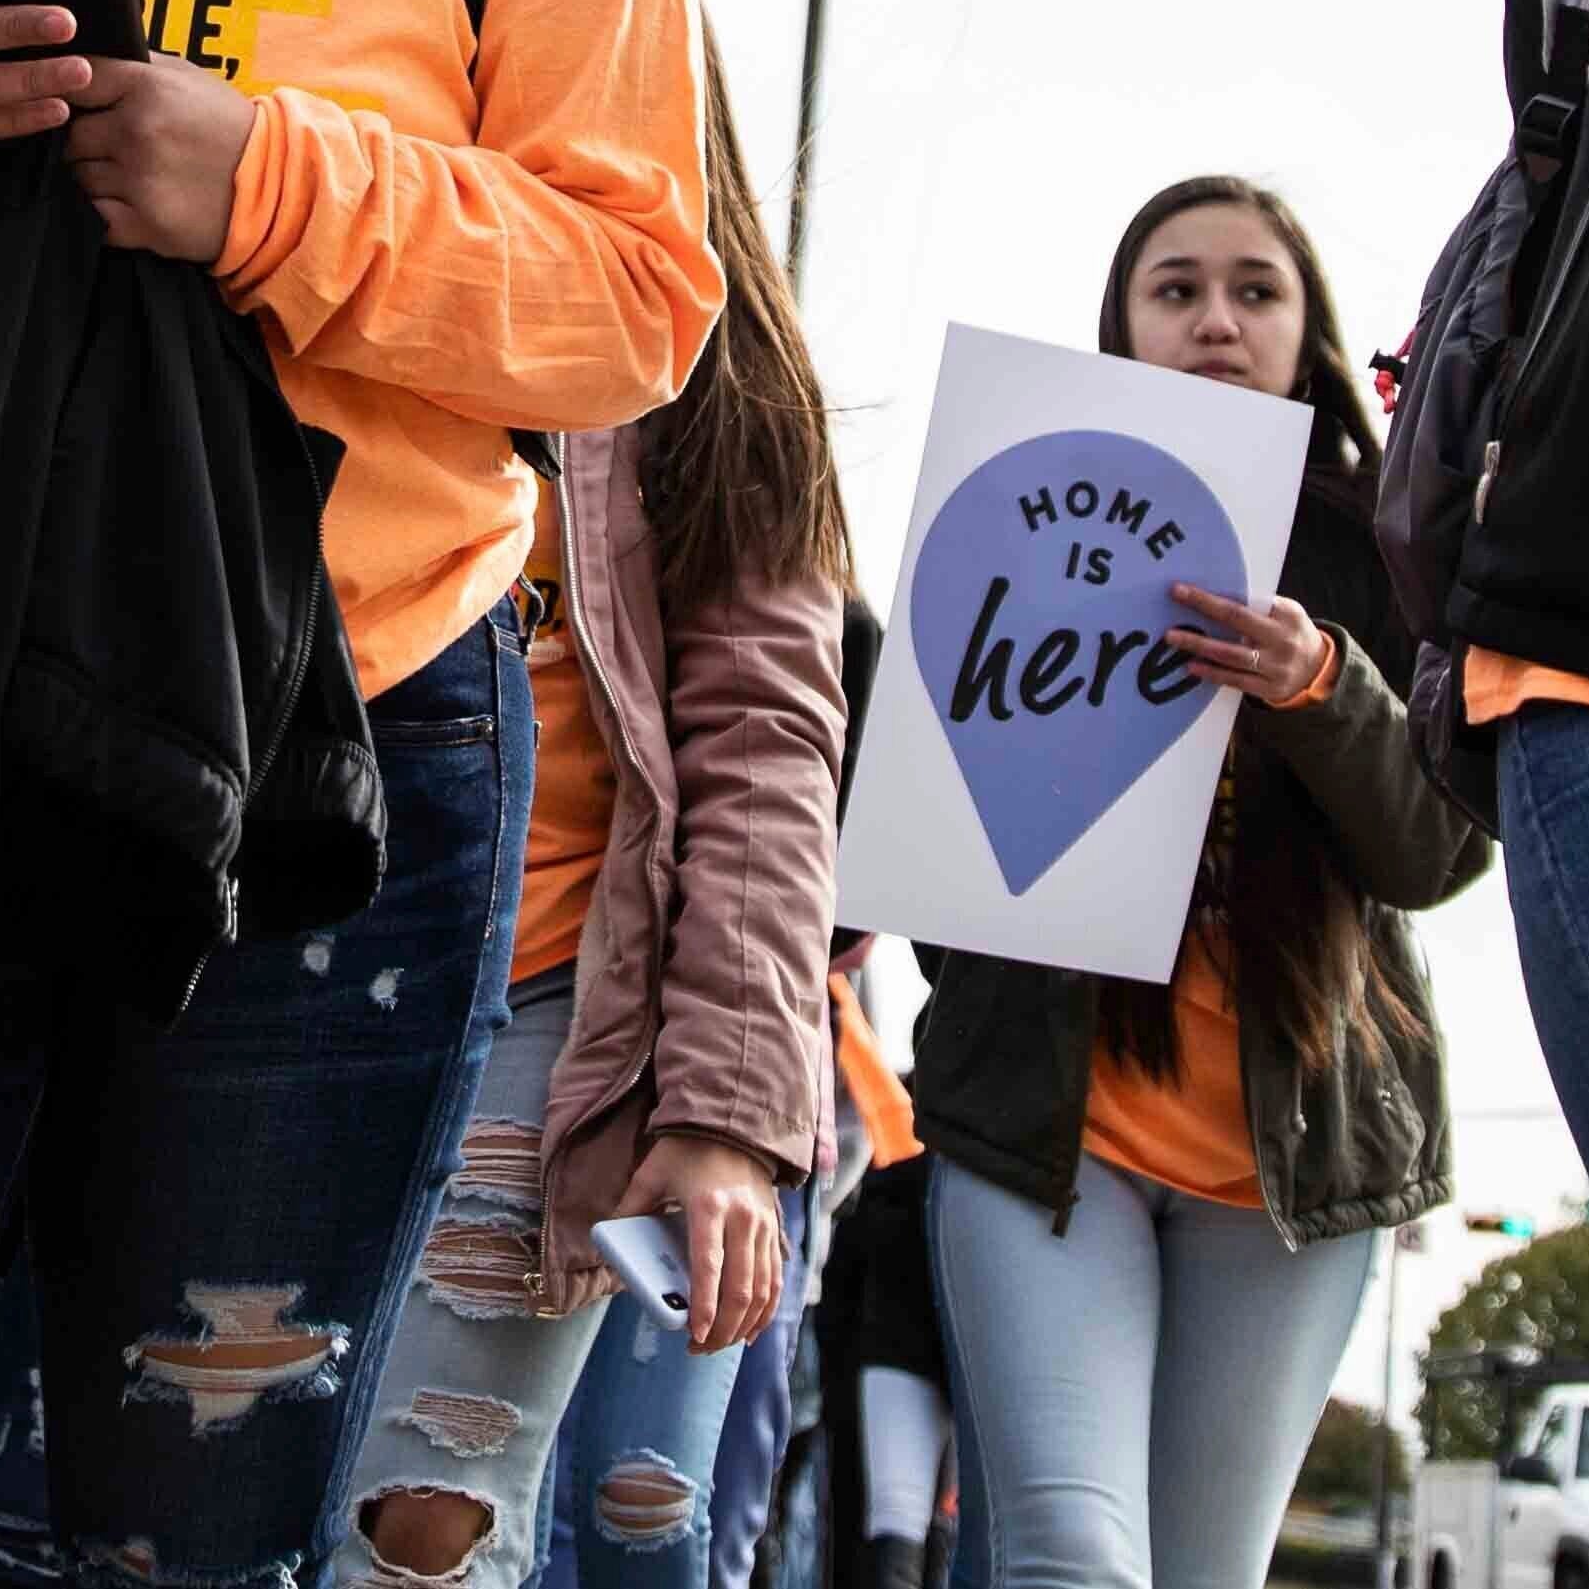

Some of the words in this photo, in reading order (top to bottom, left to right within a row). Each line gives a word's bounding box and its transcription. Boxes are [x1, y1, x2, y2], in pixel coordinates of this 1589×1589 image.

[1019, 480, 1186, 561] HOME
[1065, 542, 1114, 586] IS
[949, 576, 1208, 723] here
